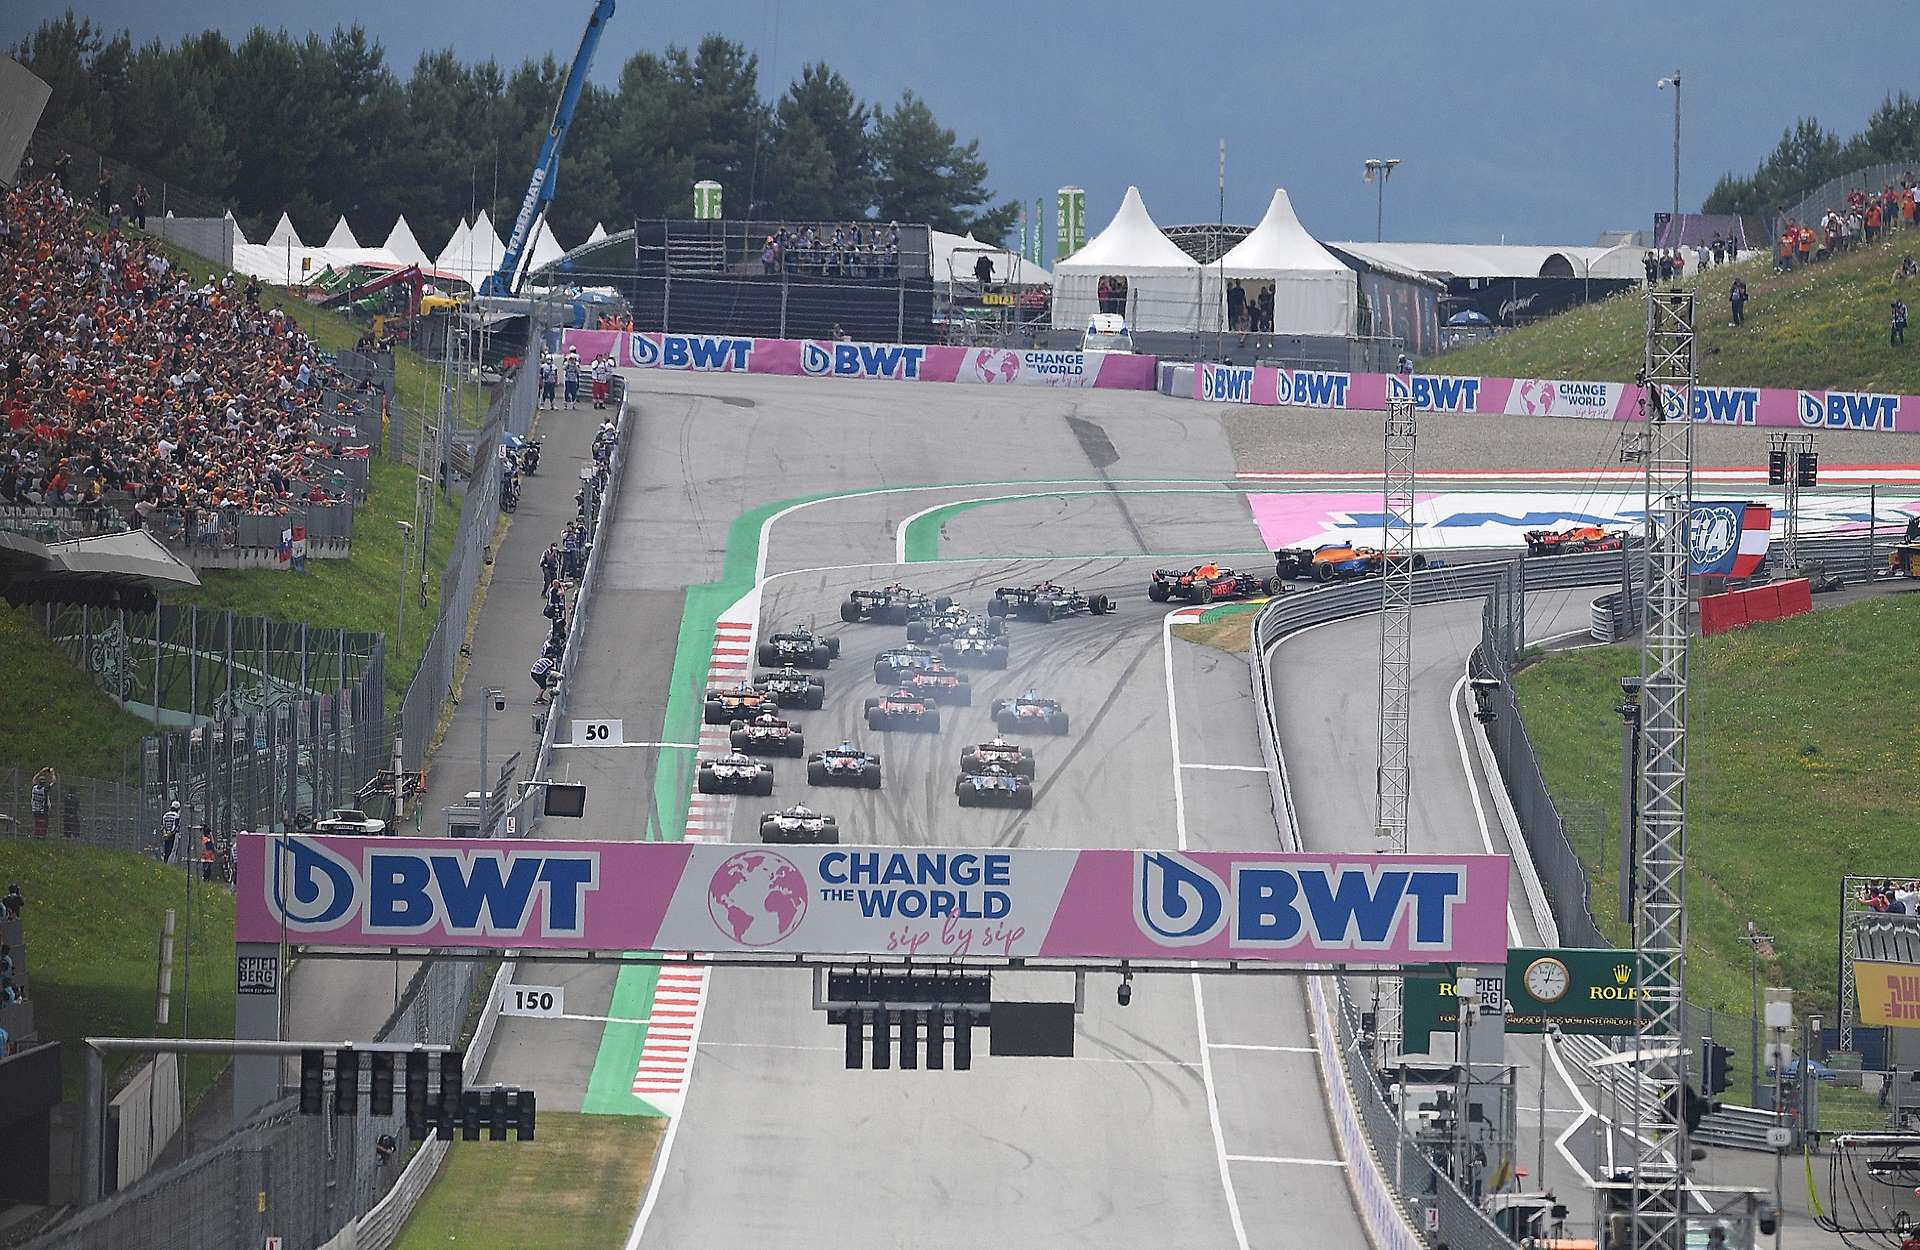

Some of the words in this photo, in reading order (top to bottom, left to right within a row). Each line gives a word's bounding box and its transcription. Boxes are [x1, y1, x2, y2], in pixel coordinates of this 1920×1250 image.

[663, 337, 752, 369] BWT
[834, 344, 923, 378] BWT
[1025, 353, 1083, 364] CHANGE
[1037, 364, 1083, 374] WORLD
[1214, 368, 1253, 400] BWT
[1294, 373, 1348, 407] BWT
[1411, 377, 1479, 410] BWT
[1560, 384, 1606, 396] CHANGE
[1568, 396, 1606, 406] WORLD
[1694, 389, 1758, 422] BWT
[1826, 395, 1898, 429] BWT
[585, 725, 609, 741] 50
[819, 852, 1011, 886] CHANGE
[370, 855, 592, 930] BWT
[820, 889, 854, 901] THE
[858, 890, 1011, 919] WORLD
[1238, 869, 1459, 943] BWT
[888, 926, 930, 954] sip
[942, 907, 973, 955] by
[983, 921, 1025, 955] sip
[240, 970, 273, 982] BERG
[1475, 979, 1501, 991] PIEL
[515, 991, 554, 1010] 150
[1590, 986, 1653, 1000] ROLEX
